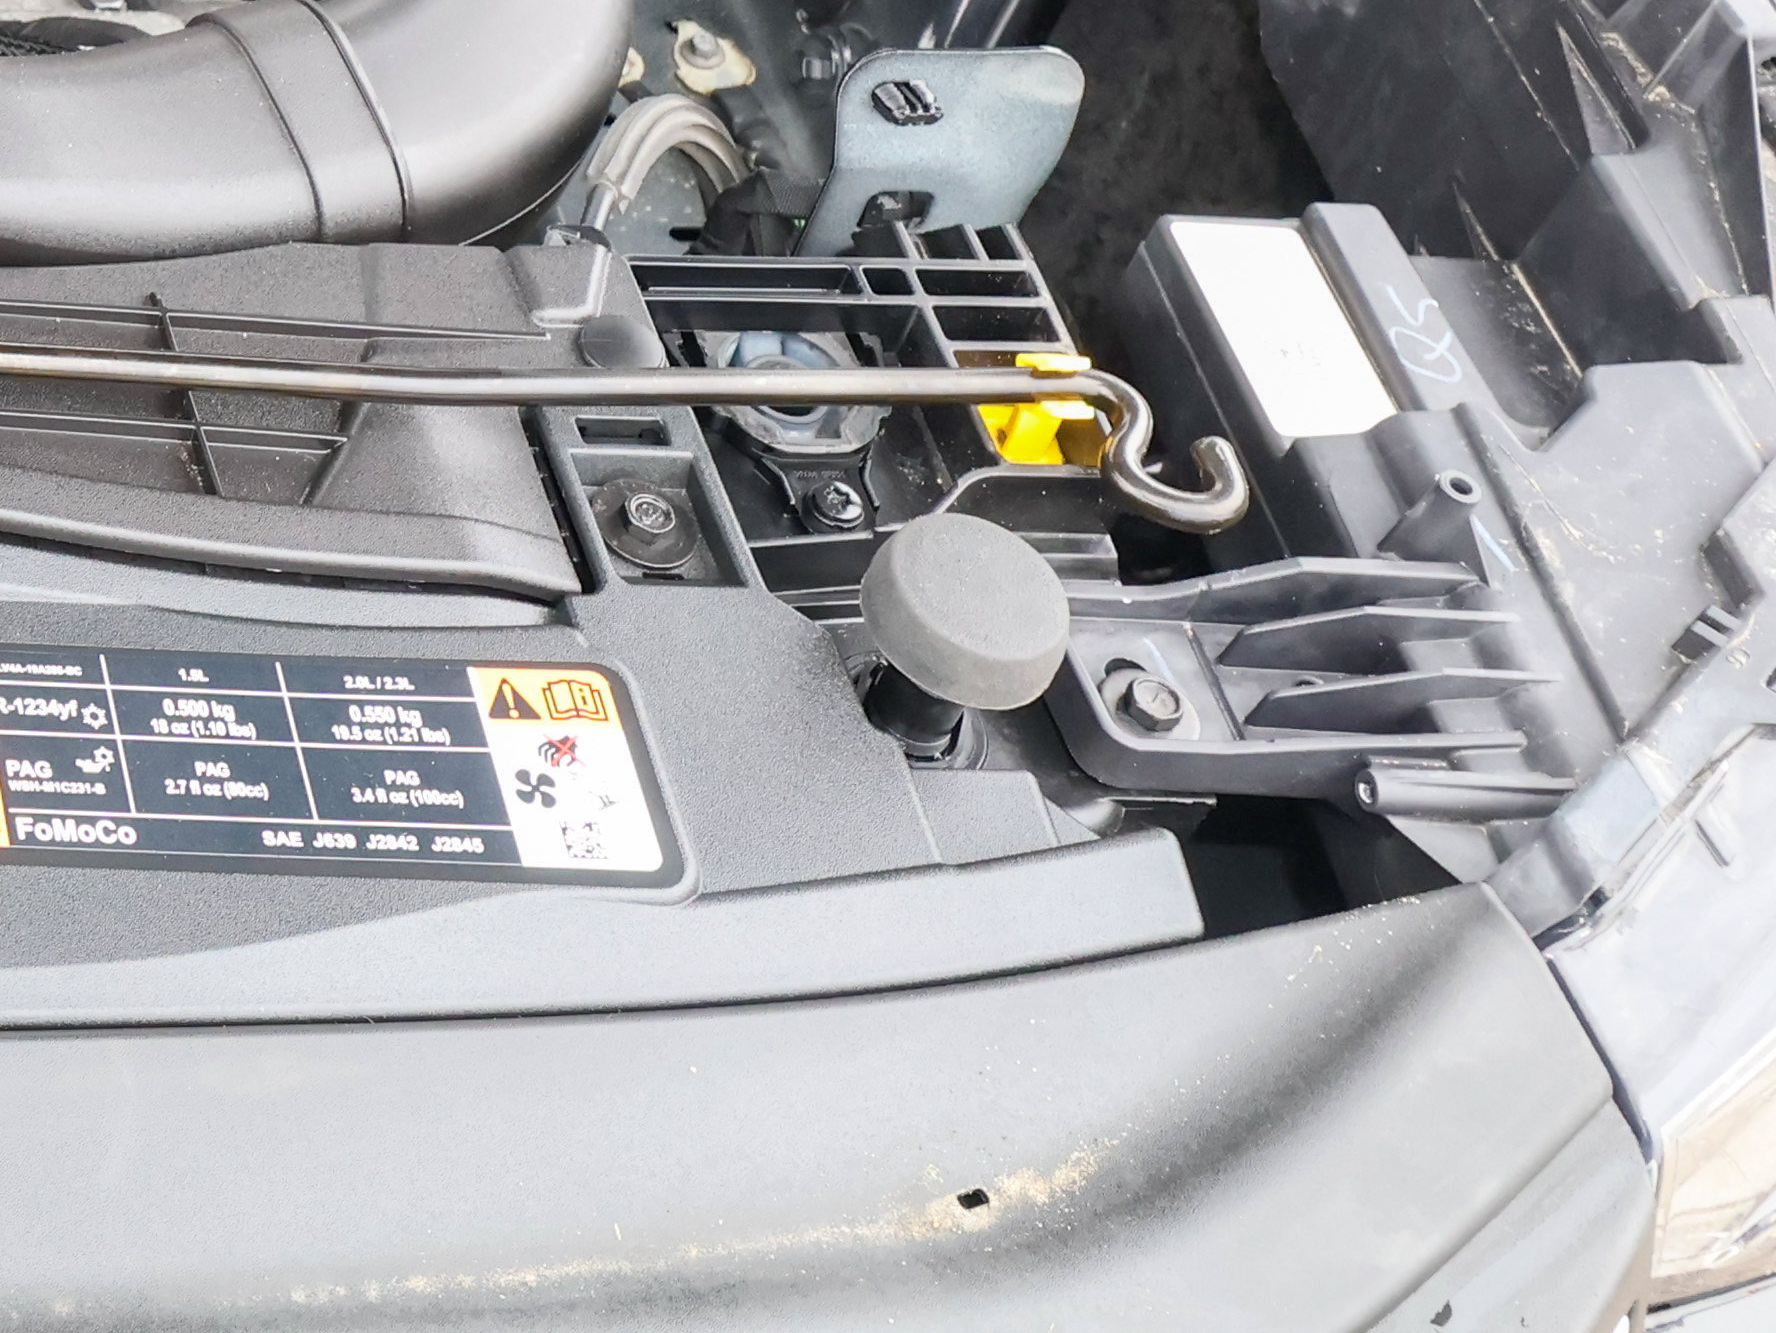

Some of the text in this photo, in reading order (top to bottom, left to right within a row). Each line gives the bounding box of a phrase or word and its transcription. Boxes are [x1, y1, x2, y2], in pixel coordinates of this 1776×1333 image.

[178, 668, 209, 682] 1.5L
[343, 675, 375, 689] 2.0L
[383, 676, 415, 691] 2.3L
[162, 698, 236, 722] 0.500 kg
[349, 705, 423, 728] 0.550 kg
[150, 718, 257, 741] 18 oz (1.10 lbs)
[331, 725, 451, 746] 19.5 oz (1.21 lbs)
[5, 759, 53, 779] PAG
[194, 761, 231, 778] PAG
[383, 769, 421, 786] PAG
[164, 779, 187, 795] 2.7
[189, 779, 201, 795] fl
[202, 783, 222, 797] oz
[351, 787, 464, 809] 3.4 fl oz (100cc)
[15, 817, 137, 845] FoMoCo
[261, 830, 485, 853] SAE J639 J2842 J2845
